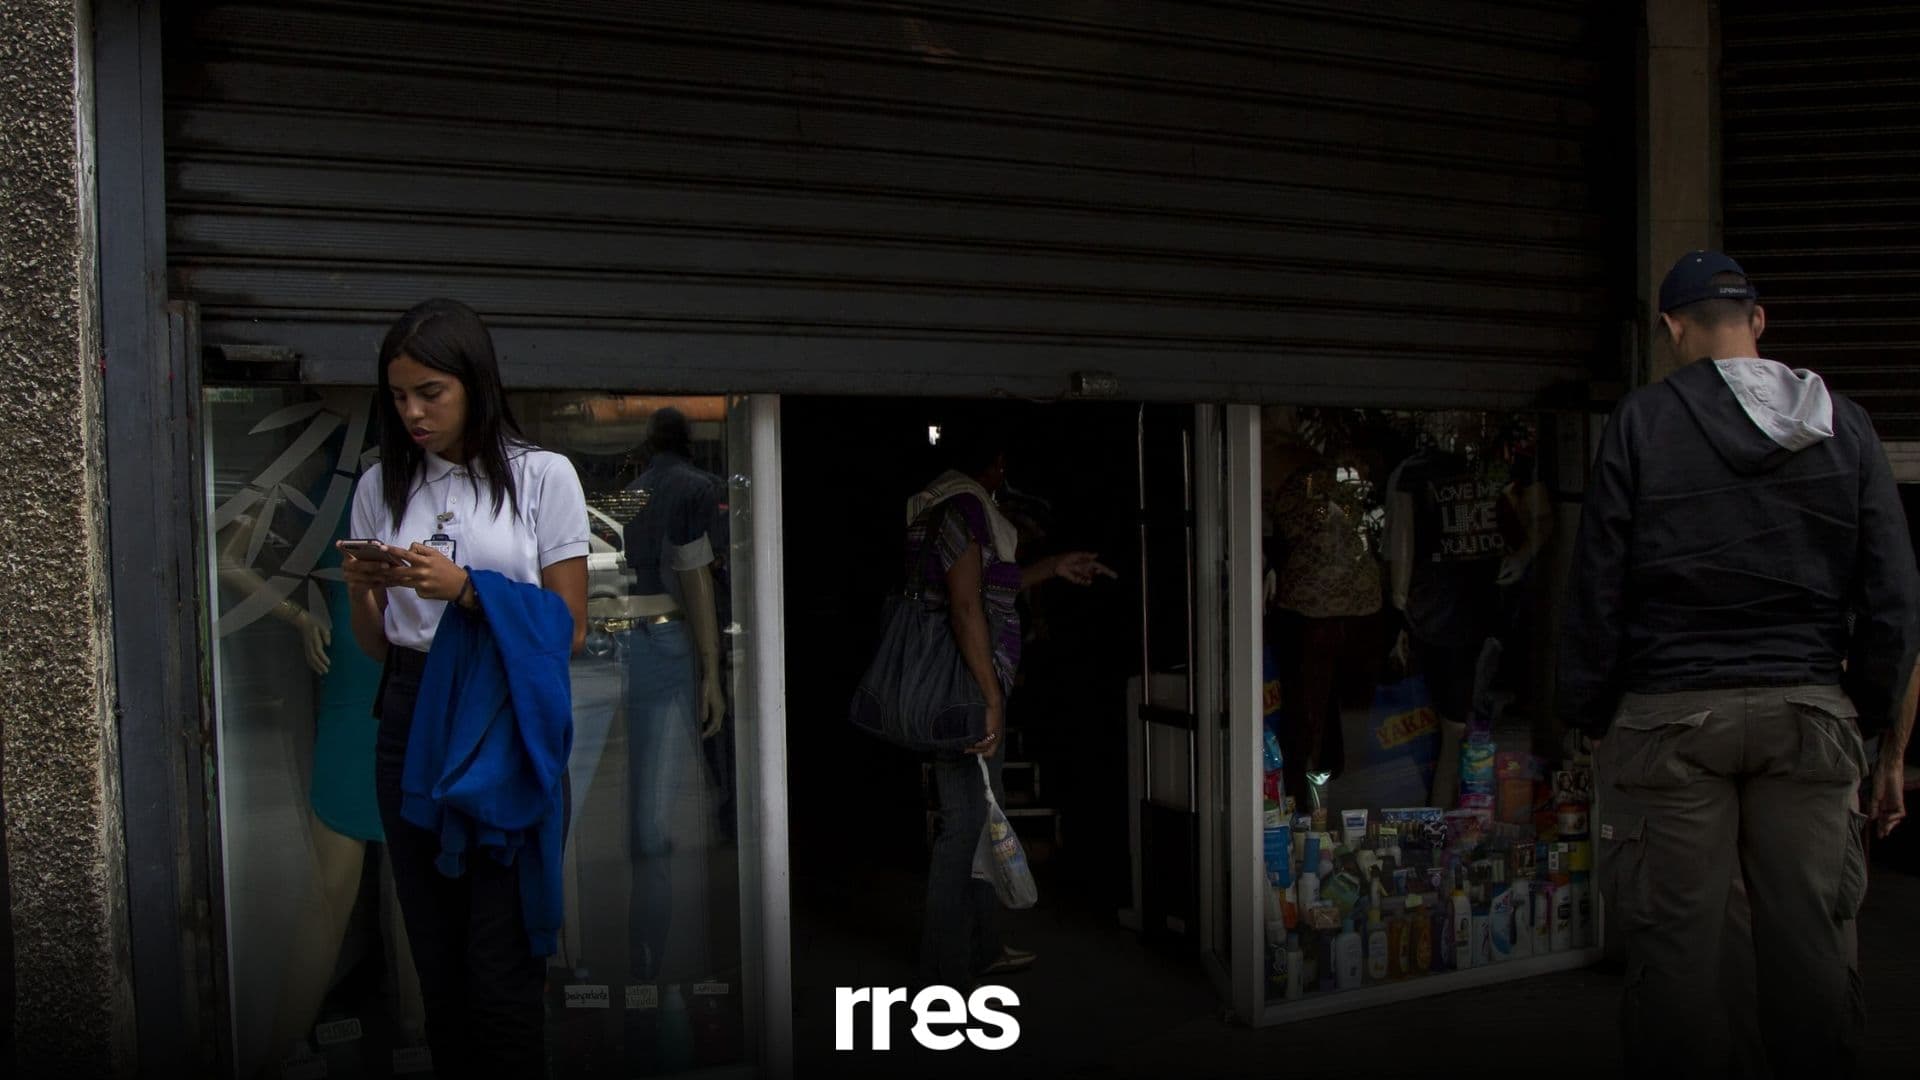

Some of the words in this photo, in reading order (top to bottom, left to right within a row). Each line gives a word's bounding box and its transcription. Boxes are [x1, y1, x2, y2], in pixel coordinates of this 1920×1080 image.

[1427, 481, 1473, 503] LOVE
[1476, 481, 1503, 499] ME
[1441, 502, 1498, 533] LIKE
[1440, 536, 1477, 555] YOU
[1479, 533, 1504, 553] DO
